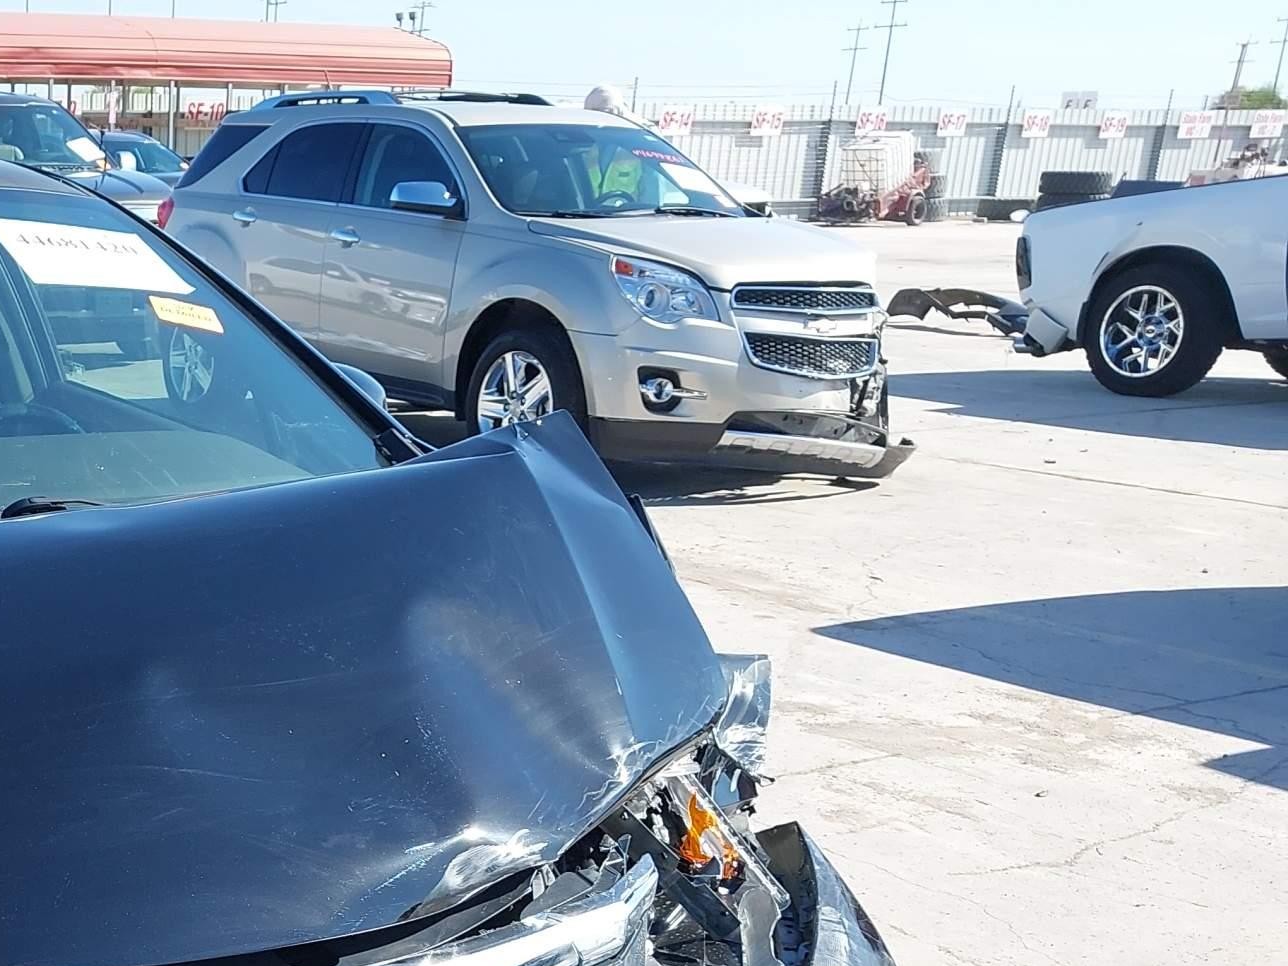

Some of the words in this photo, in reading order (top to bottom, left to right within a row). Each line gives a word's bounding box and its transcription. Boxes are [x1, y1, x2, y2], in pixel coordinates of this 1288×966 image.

[660, 111, 691, 129] SF-14
[753, 111, 783, 129] SF-15
[940, 113, 966, 130] SF-17
